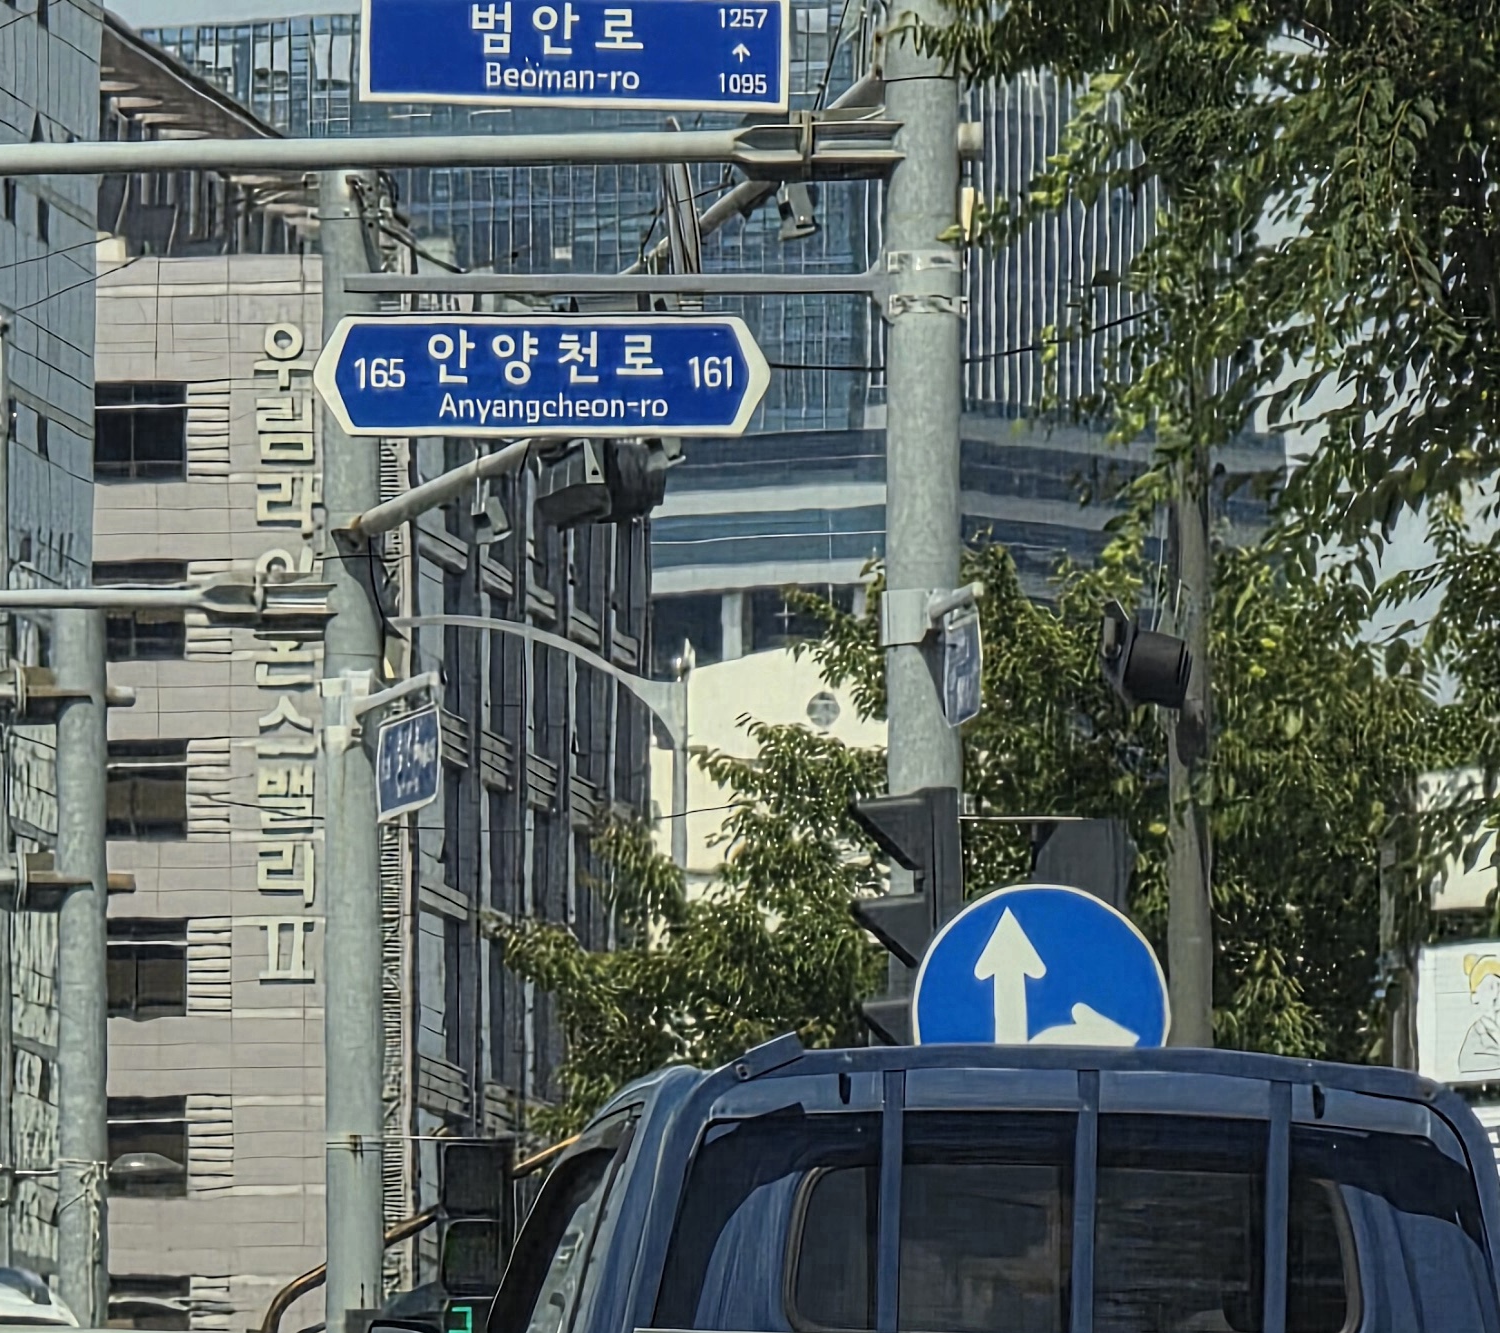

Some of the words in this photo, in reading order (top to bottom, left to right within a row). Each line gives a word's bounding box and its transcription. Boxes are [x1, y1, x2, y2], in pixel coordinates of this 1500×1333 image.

[471, 1, 644, 55] 범안로
[718, 7, 769, 29] 1257
[485, 61, 641, 91] Beoman-ro
[718, 72, 768, 95] 1095
[354, 357, 407, 389] 165
[427, 328, 664, 386] 안양천로
[688, 355, 734, 389] 161
[438, 392, 669, 424] Anyangcheon-ro
